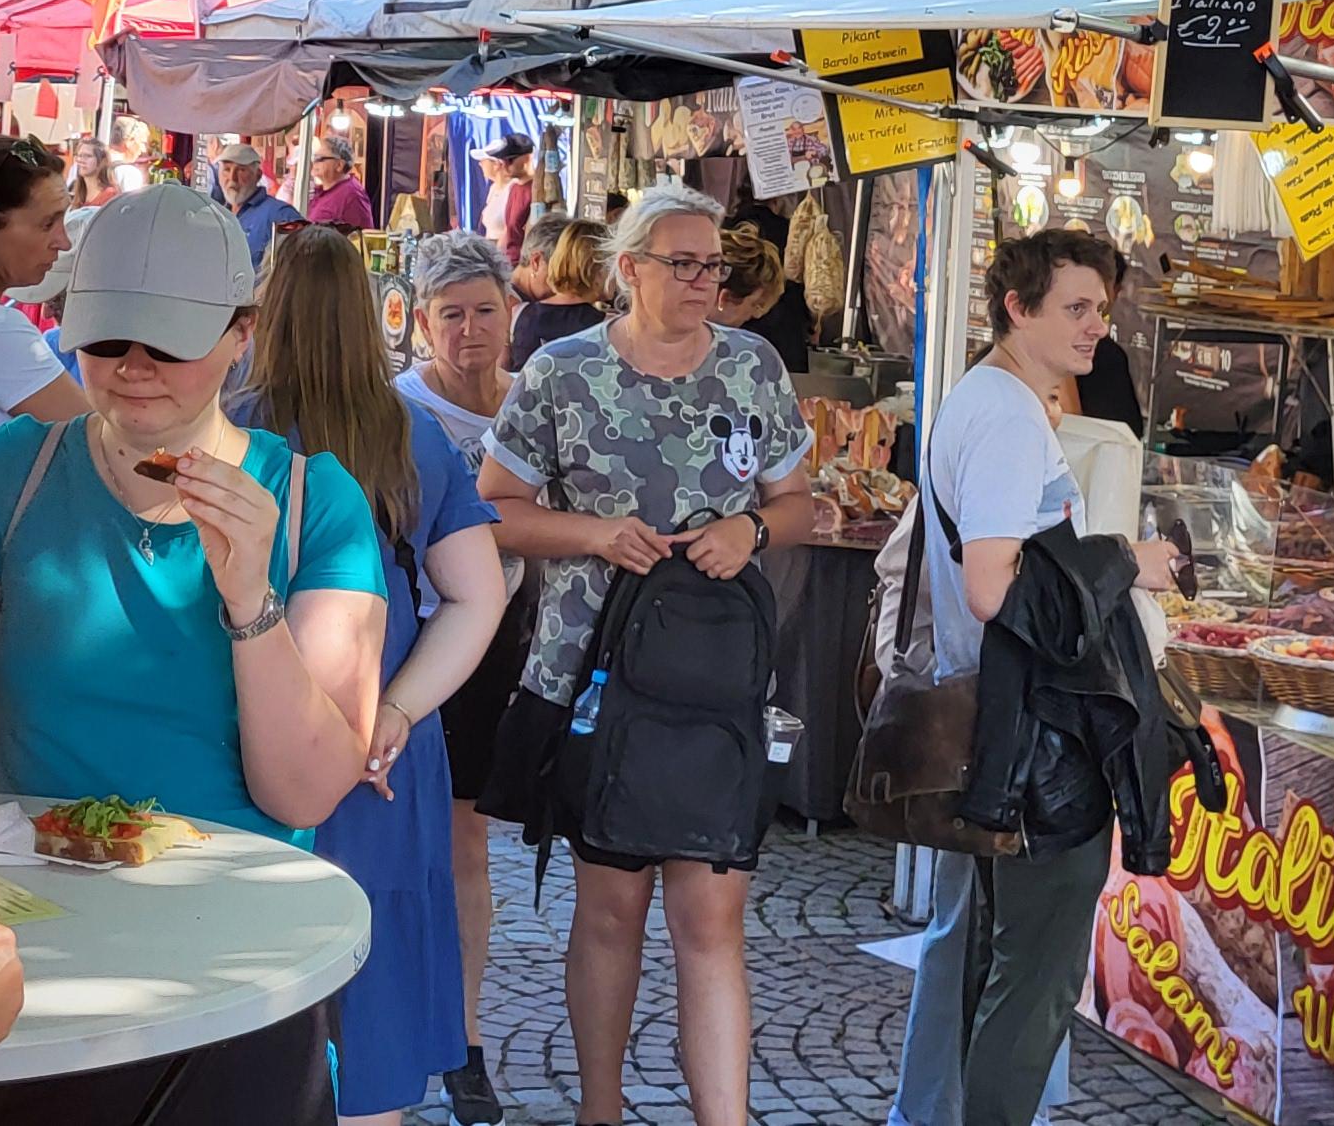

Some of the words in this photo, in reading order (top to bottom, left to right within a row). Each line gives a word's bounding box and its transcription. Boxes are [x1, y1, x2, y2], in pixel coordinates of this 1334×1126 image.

[841, 29, 882, 45] Pikant
[822, 53, 859, 69] Barolo
[862, 46, 908, 63] Rotwein
[874, 106, 895, 120] Mit
[847, 132, 865, 143] Mit
[868, 123, 907, 137] Trüffel
[893, 140, 915, 155] Mit
[1109, 880, 1240, 1089] Salami
